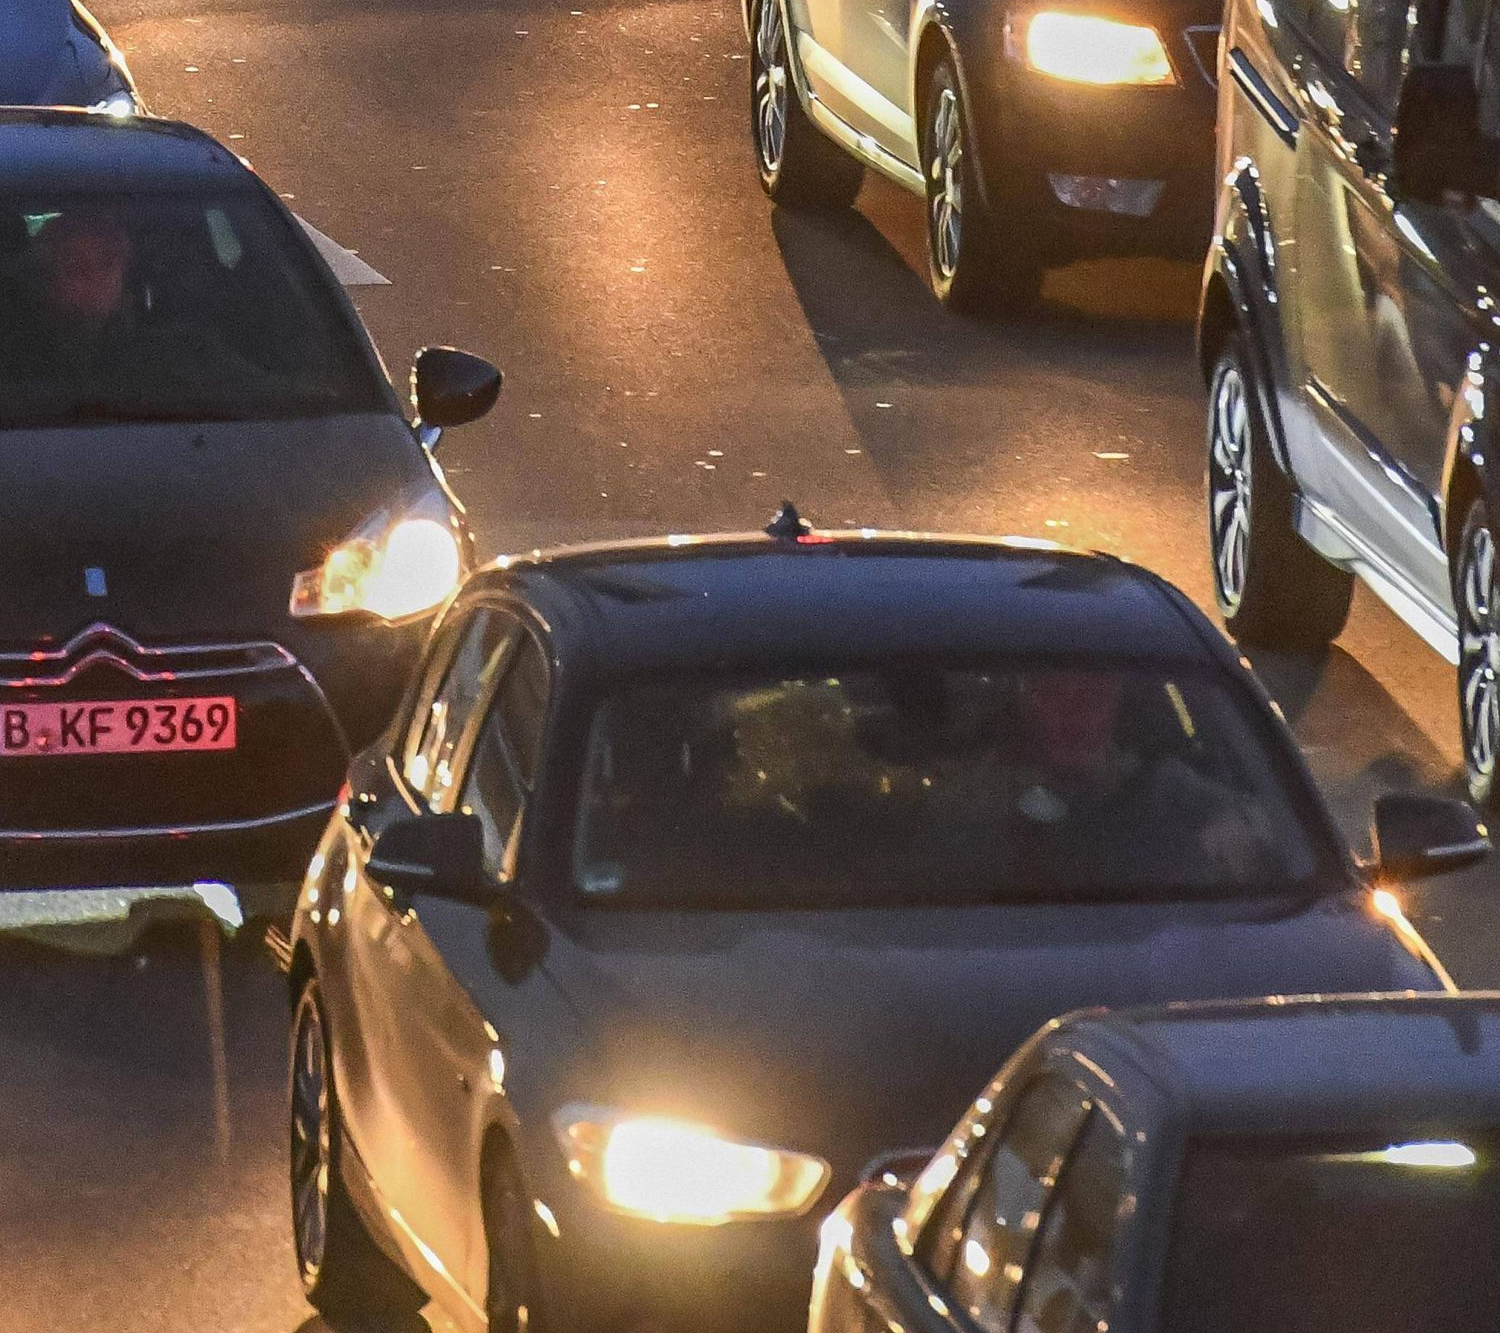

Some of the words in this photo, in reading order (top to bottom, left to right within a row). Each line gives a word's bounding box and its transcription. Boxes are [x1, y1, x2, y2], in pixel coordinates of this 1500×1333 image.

[4, 709, 30, 750] B
[59, 706, 114, 748] KF
[125, 703, 230, 745] 9369
